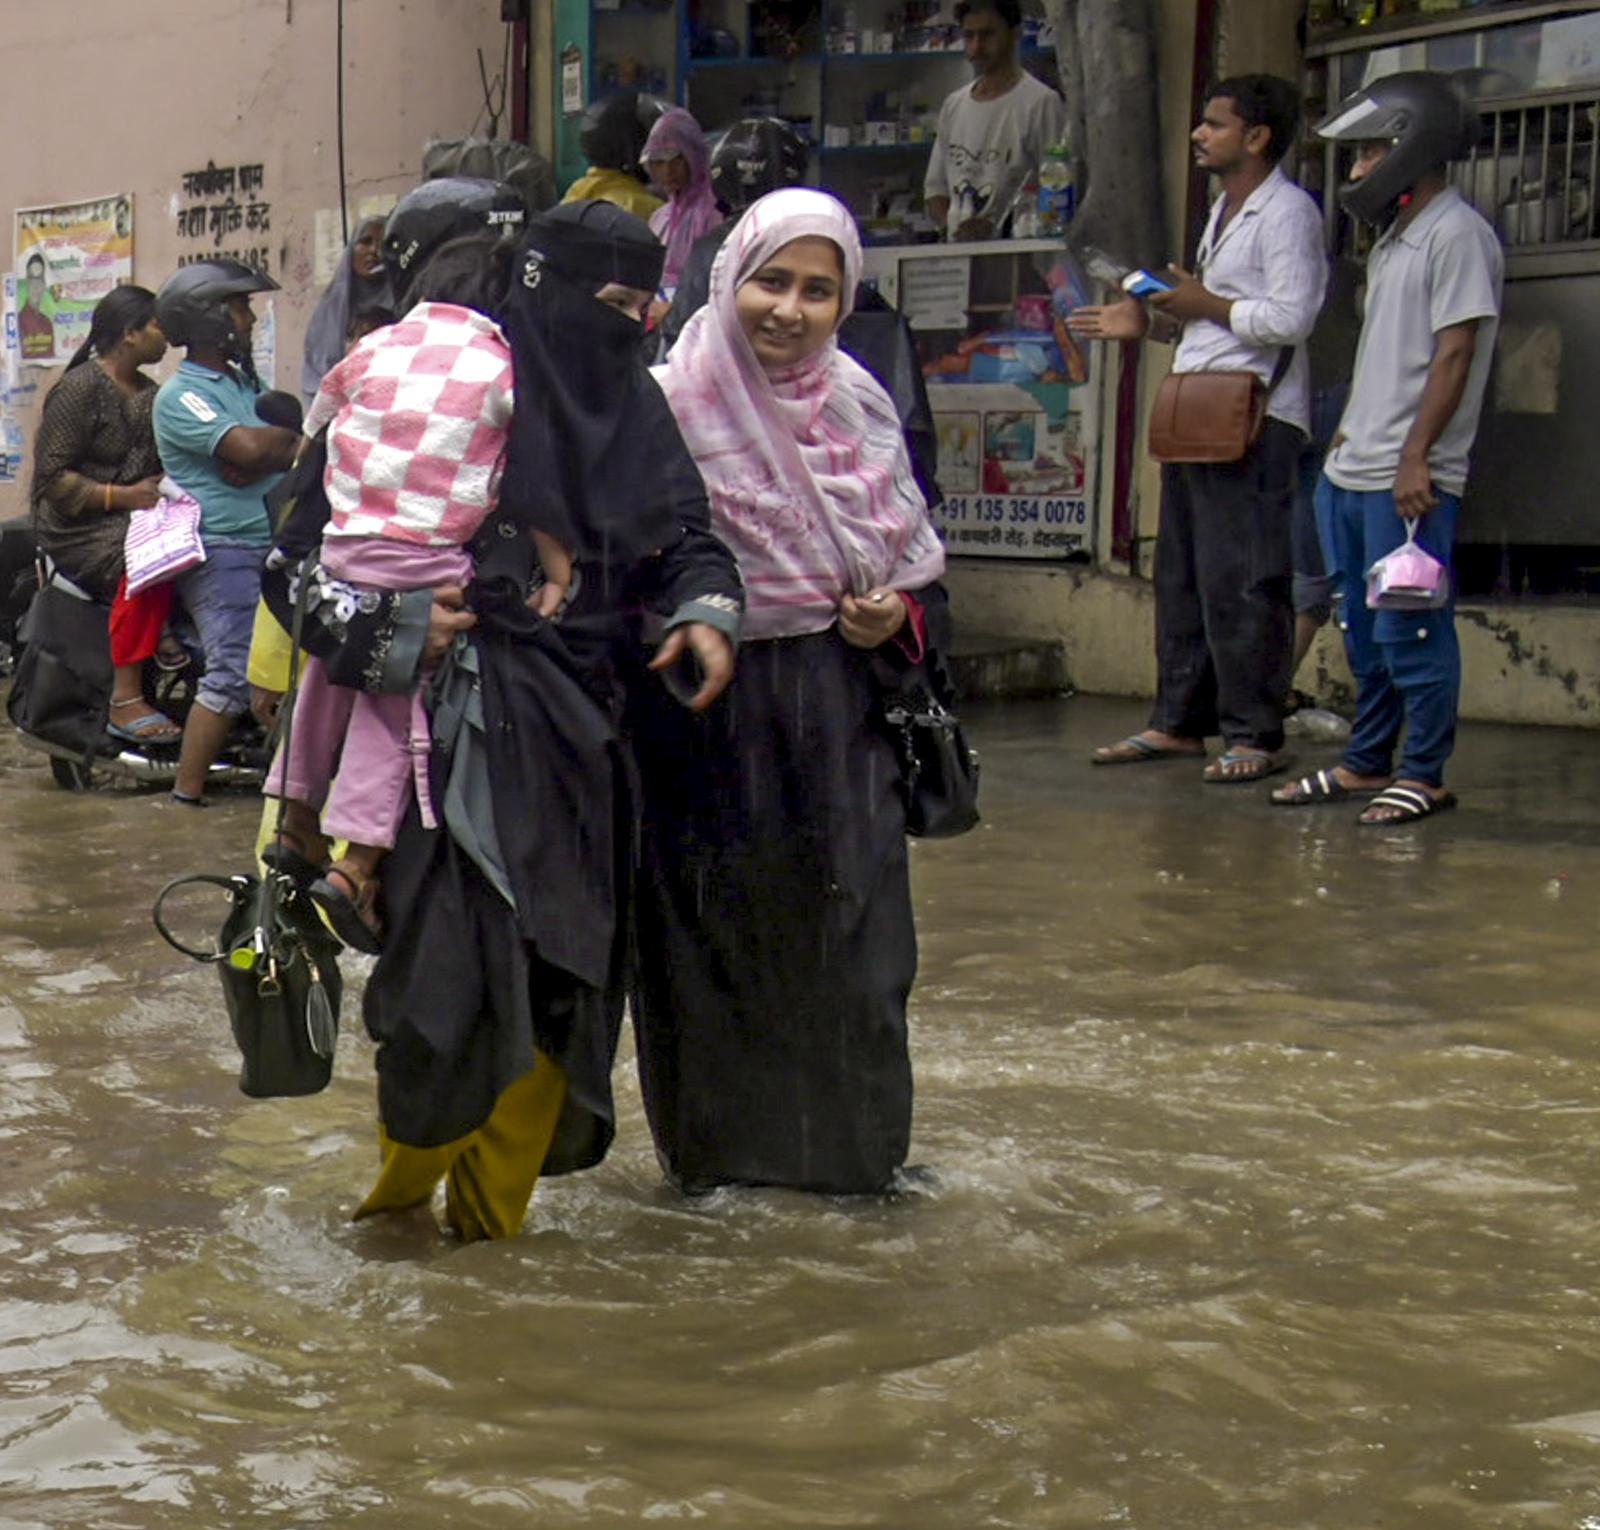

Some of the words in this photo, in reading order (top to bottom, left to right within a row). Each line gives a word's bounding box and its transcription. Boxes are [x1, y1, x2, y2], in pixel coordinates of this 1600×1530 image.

[975, 500, 1004, 522] 135
[1009, 501, 1040, 523] 354
[1045, 502, 1086, 525] 0078
